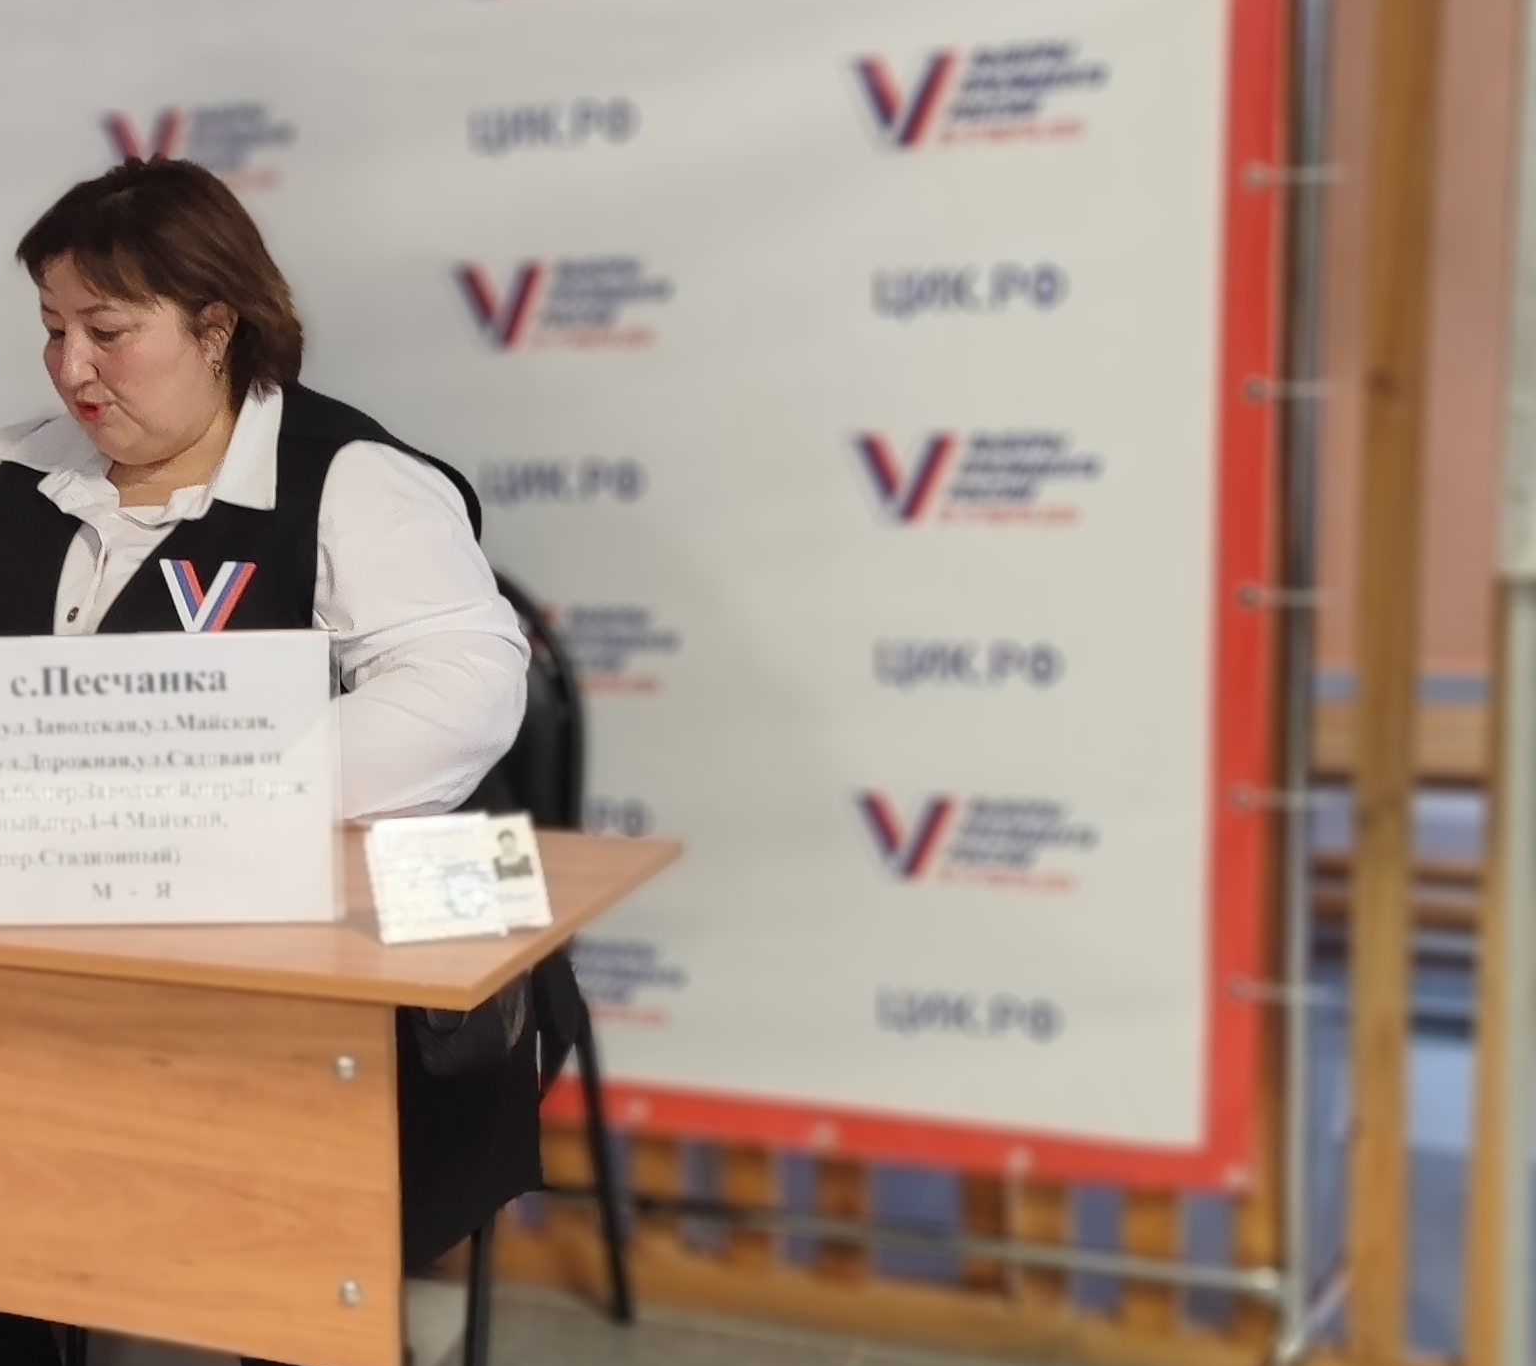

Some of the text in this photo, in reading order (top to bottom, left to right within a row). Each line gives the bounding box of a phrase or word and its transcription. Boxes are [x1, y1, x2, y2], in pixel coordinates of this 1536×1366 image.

[467, 97, 640, 157] ЦИК.РФ
[871, 263, 1069, 321] ЦИК.РФ
[477, 457, 648, 507] ЦИК.РФ
[10, 666, 227, 698] с.Песчанка
[873, 638, 1066, 690] ЦИК.РФ
[91, 883, 112, 900] М
[155, 881, 172, 900] Я
[874, 986, 1064, 1041] ЦИК.РФ
